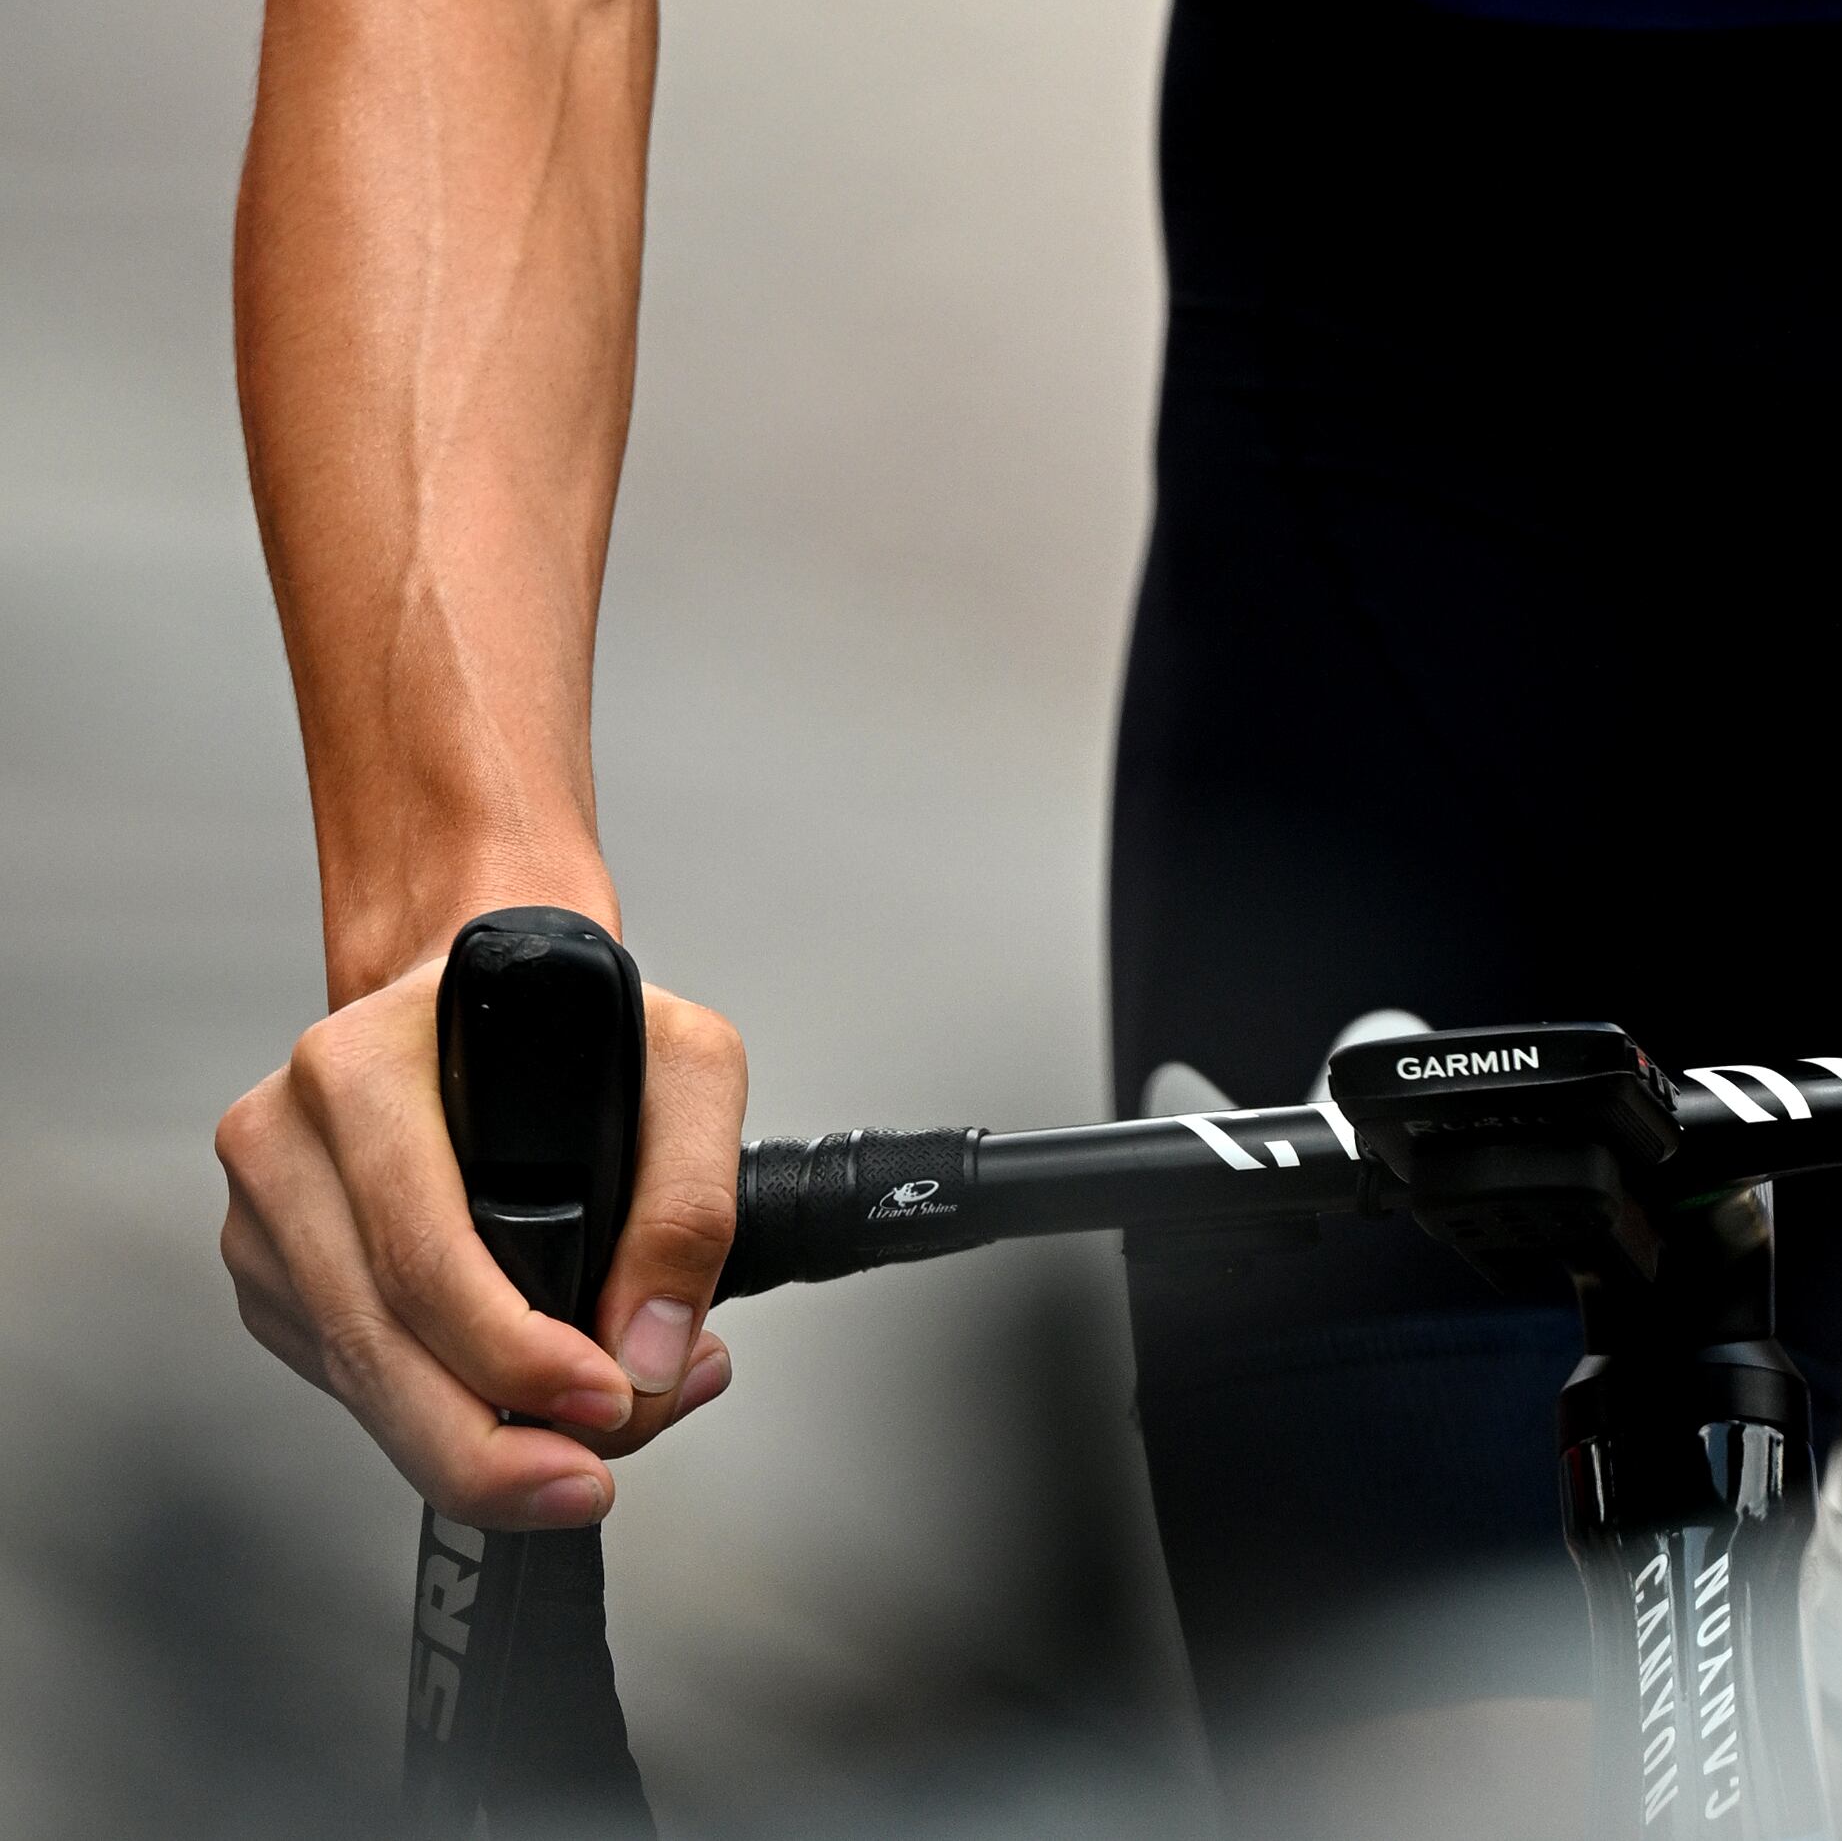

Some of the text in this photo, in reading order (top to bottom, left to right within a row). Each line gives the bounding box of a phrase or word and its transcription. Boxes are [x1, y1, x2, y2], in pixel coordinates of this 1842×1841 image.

[1396, 1046, 1540, 1080] GARMIN
[867, 1201, 958, 1219] Lizard Skins
[1634, 1552, 1679, 1826] CANYON
[1694, 1552, 1743, 1821] CANYON
